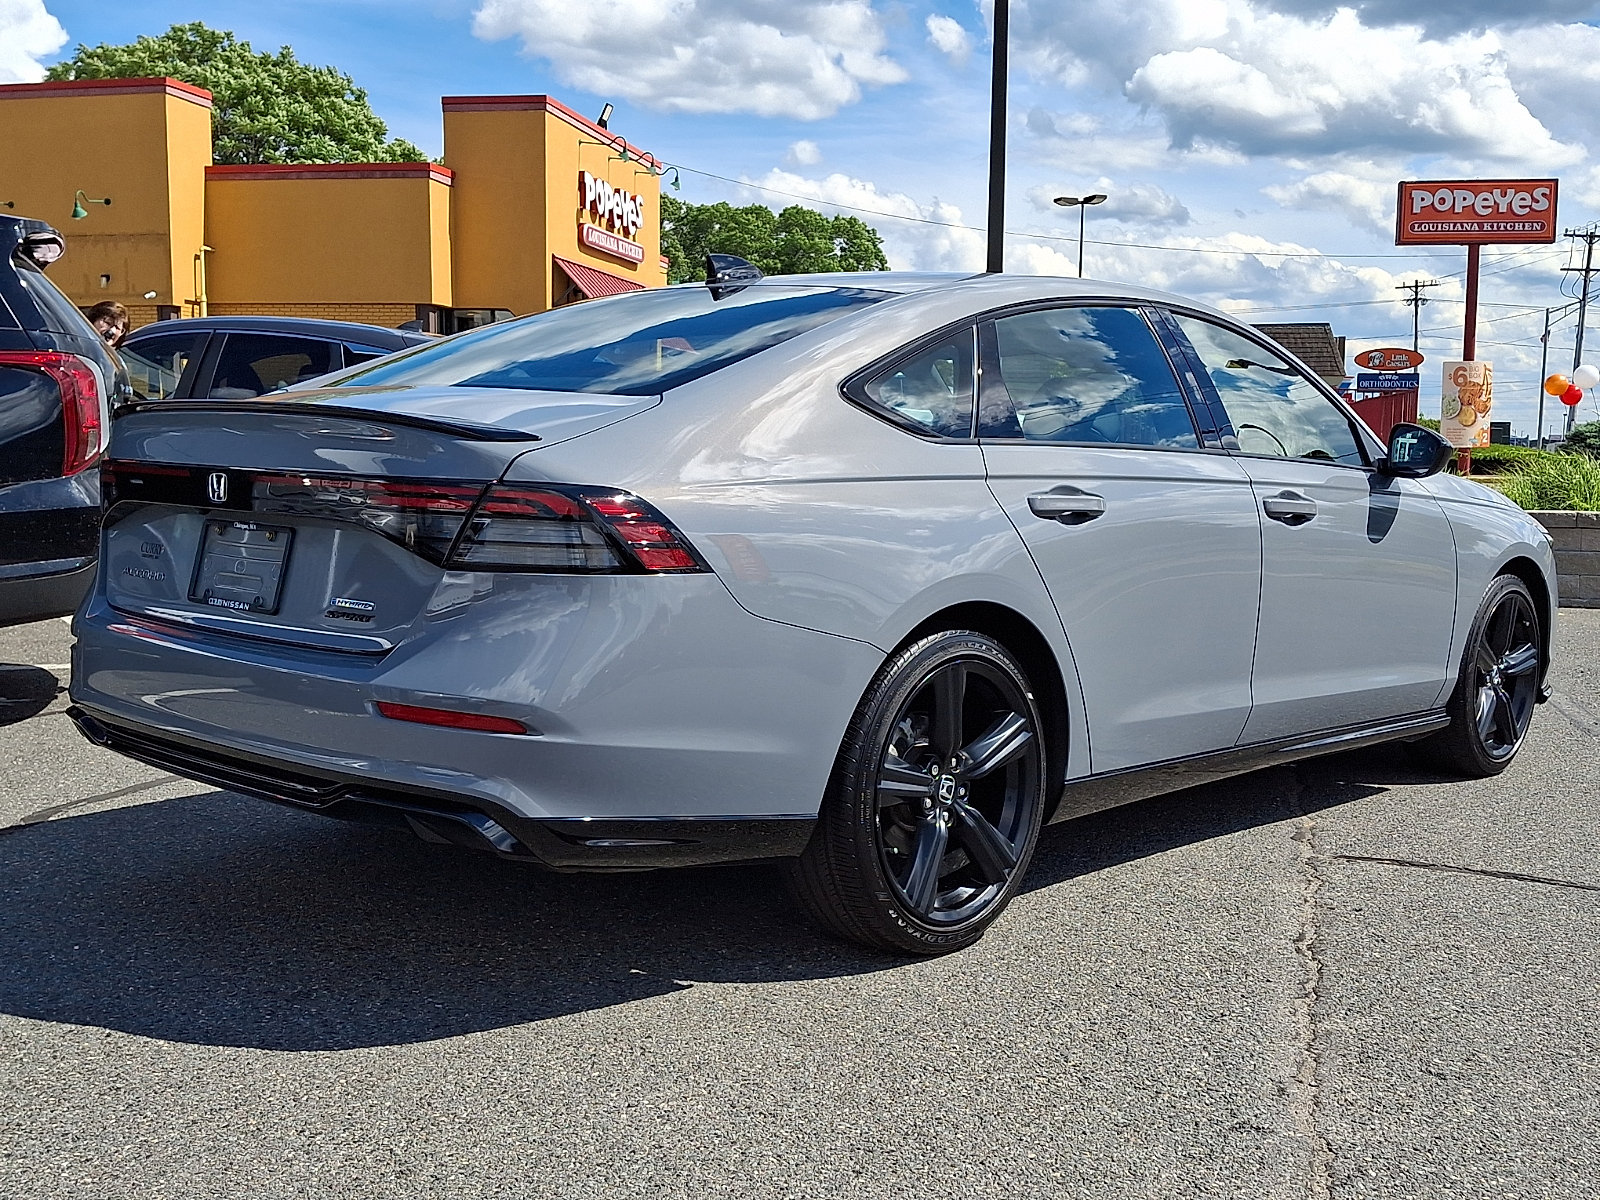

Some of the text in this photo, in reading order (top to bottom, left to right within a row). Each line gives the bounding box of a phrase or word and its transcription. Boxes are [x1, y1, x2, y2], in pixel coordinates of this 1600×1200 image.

[1413, 222, 1542, 232] LOUISIANA KITCHEN
[588, 228, 643, 260] LOUISIANA KITCHEN
[1391, 353, 1409, 361] Little
[1385, 359, 1411, 367] Caesars
[1359, 380, 1419, 388] ORTHODONTICS
[122, 566, 166, 581] ACCORD
[336, 599, 373, 609] HYBRID
